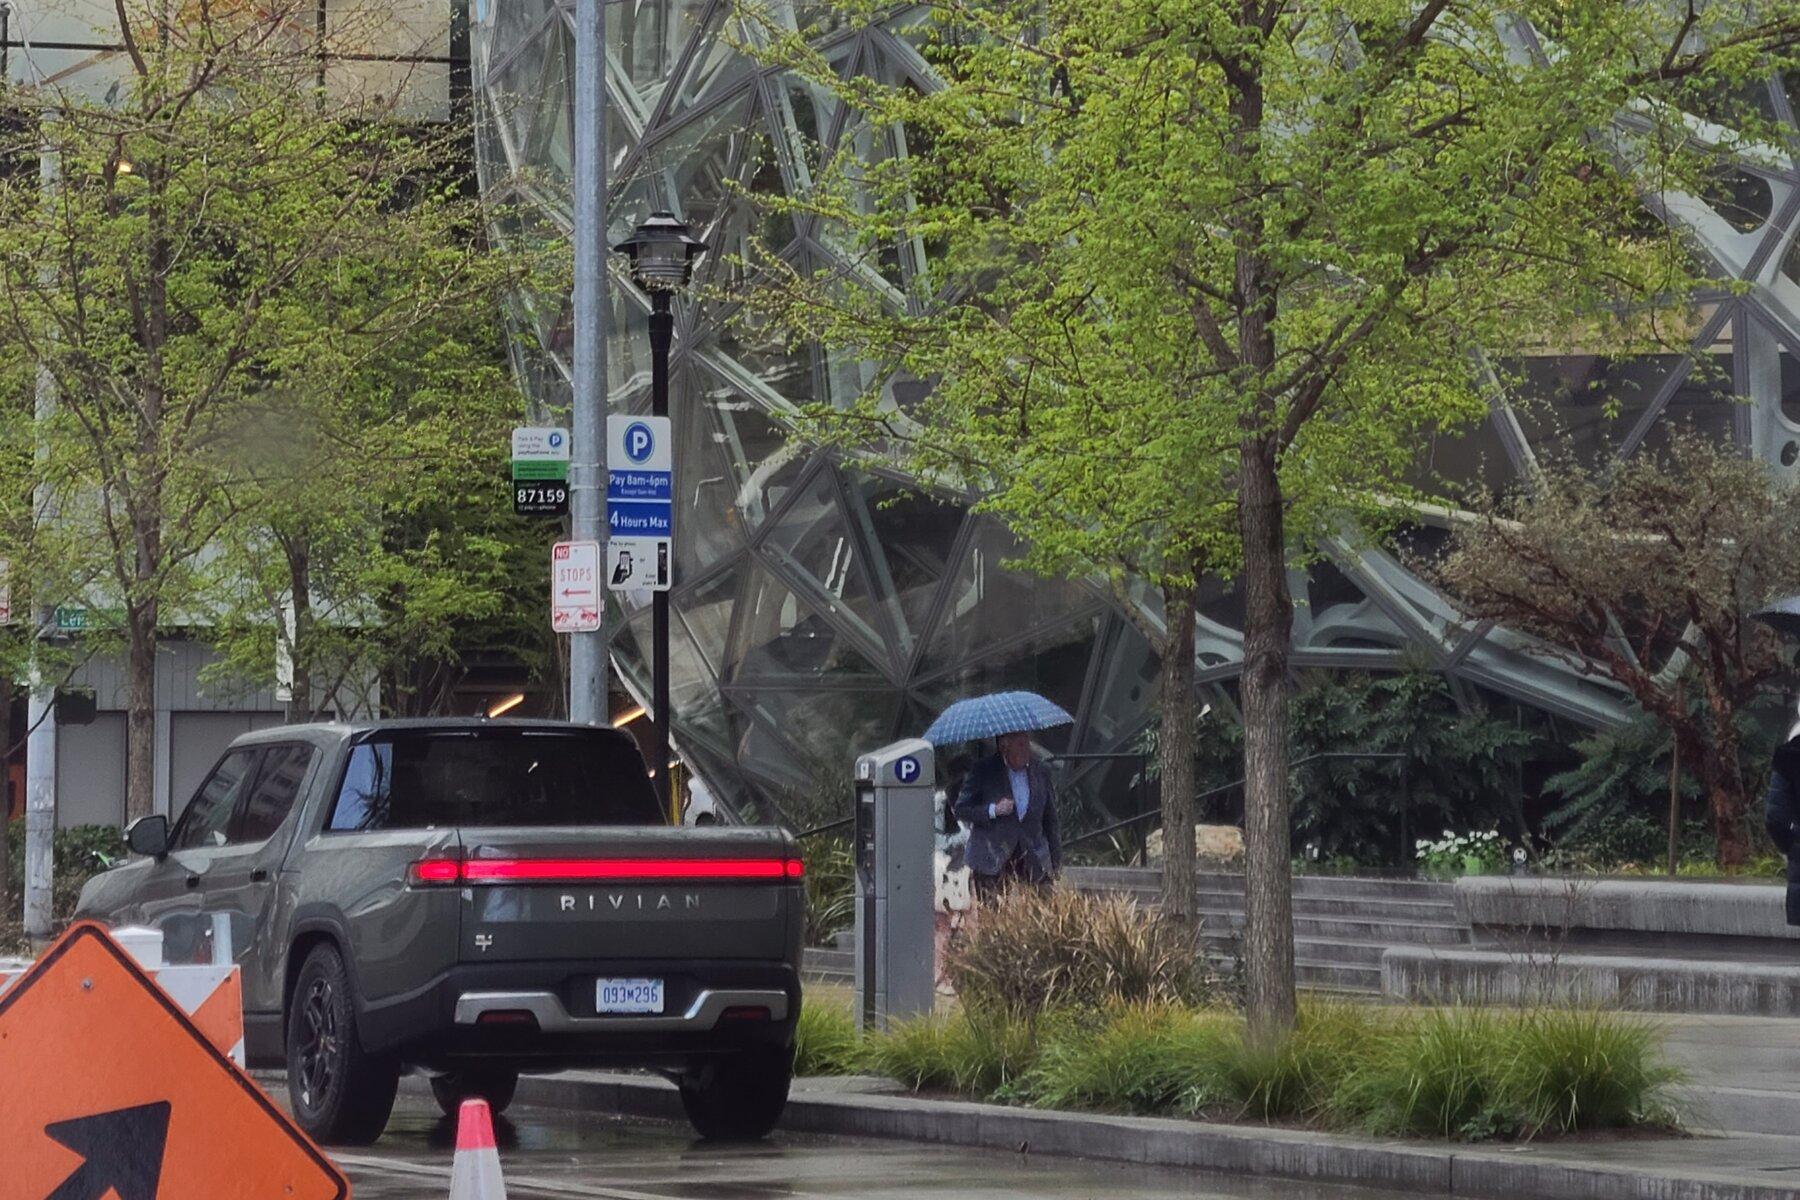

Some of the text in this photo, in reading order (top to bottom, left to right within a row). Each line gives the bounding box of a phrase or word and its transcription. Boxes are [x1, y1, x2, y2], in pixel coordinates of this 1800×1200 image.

[552, 434, 561, 446] P
[632, 431, 648, 456] P
[609, 474, 669, 487] Pay 8am-6pm
[517, 488, 566, 504] 87159
[610, 510, 669, 529] 4 Hours Max
[556, 546, 569, 559] NO
[560, 568, 592, 582] STOPS
[901, 760, 916, 780] P
[560, 894, 700, 911] RIVIAN
[603, 986, 658, 1004] 093M296
